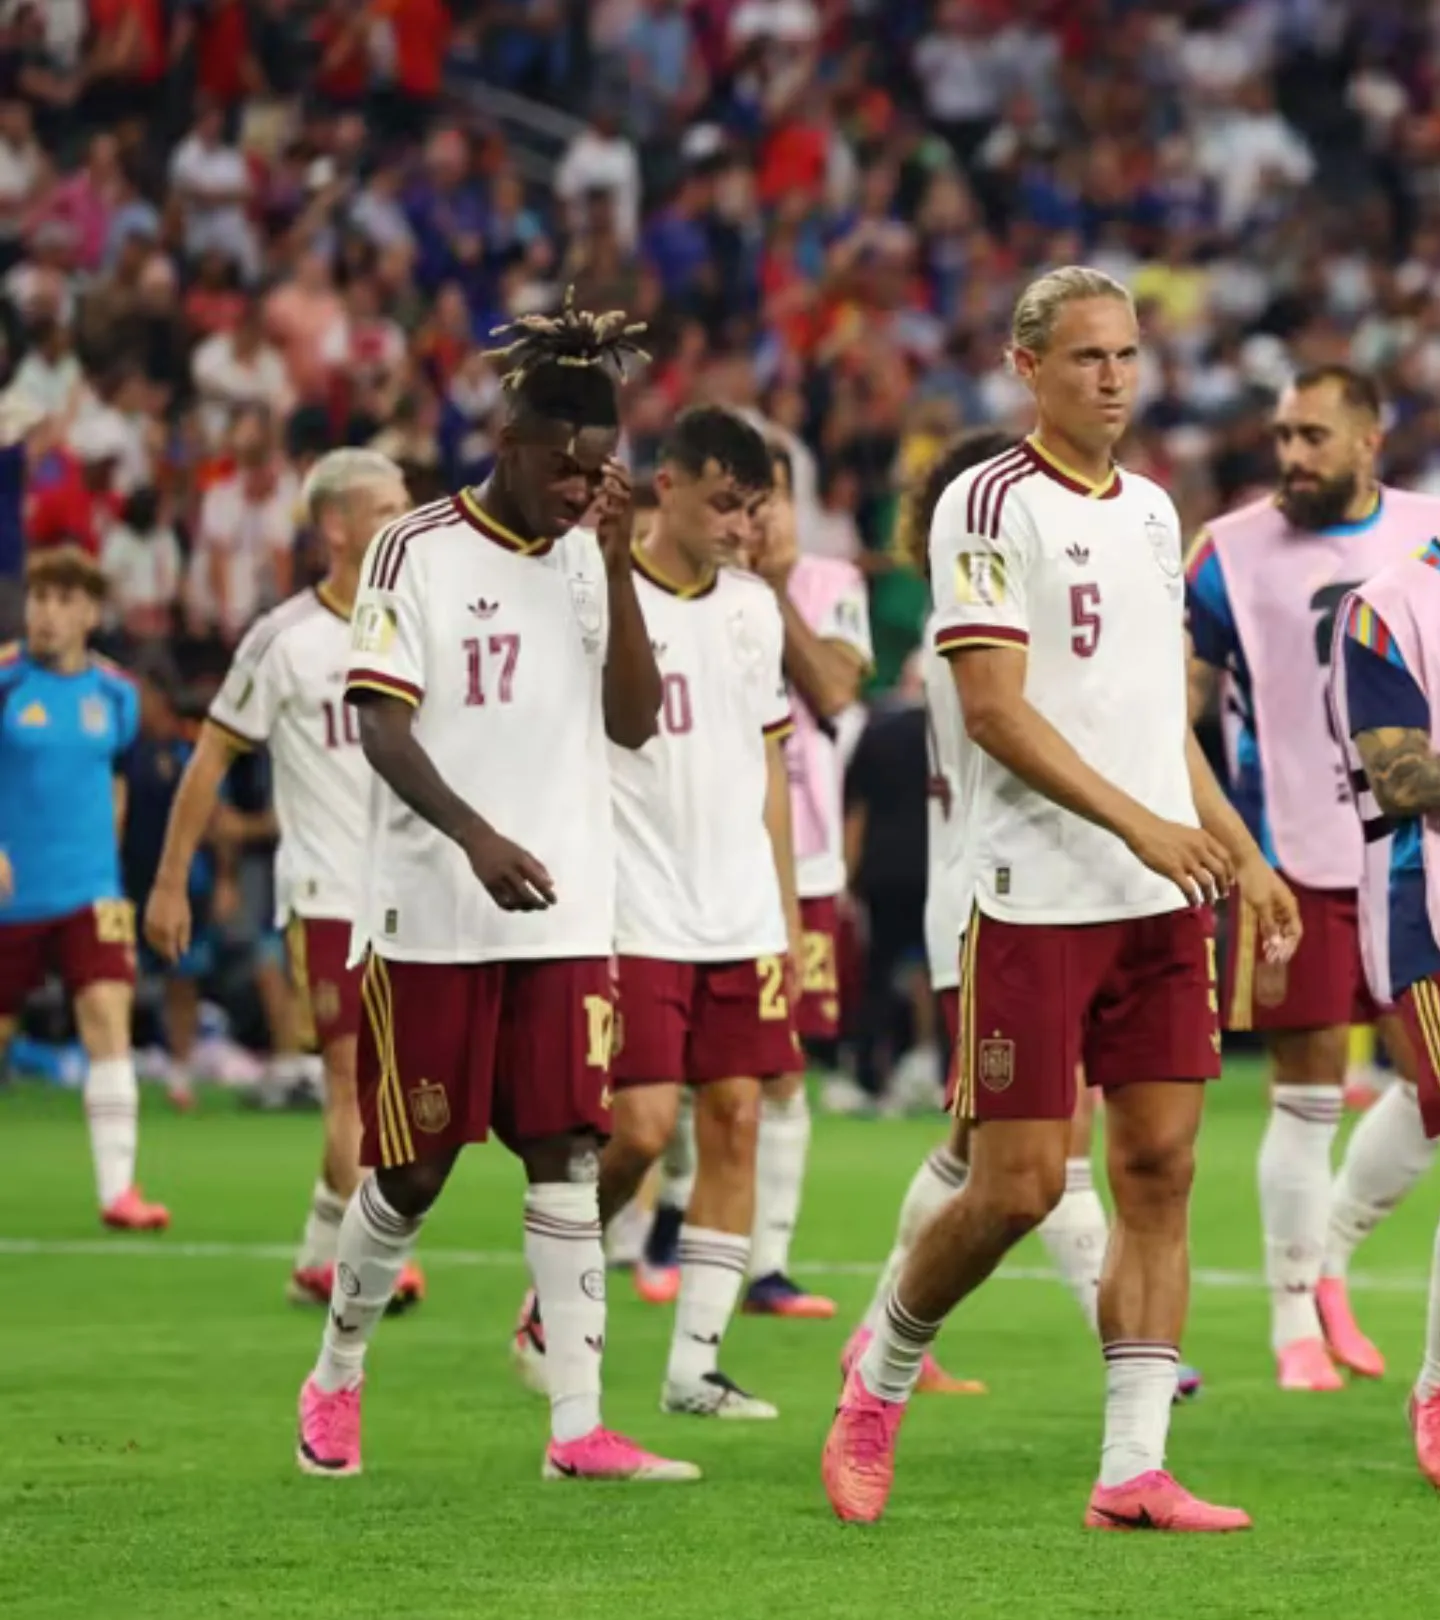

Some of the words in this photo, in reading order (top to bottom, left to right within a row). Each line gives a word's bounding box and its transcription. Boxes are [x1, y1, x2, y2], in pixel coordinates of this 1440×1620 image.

[1069, 582, 1101, 659] 5
[462, 633, 521, 706] 17
[655, 672, 693, 735] 0
